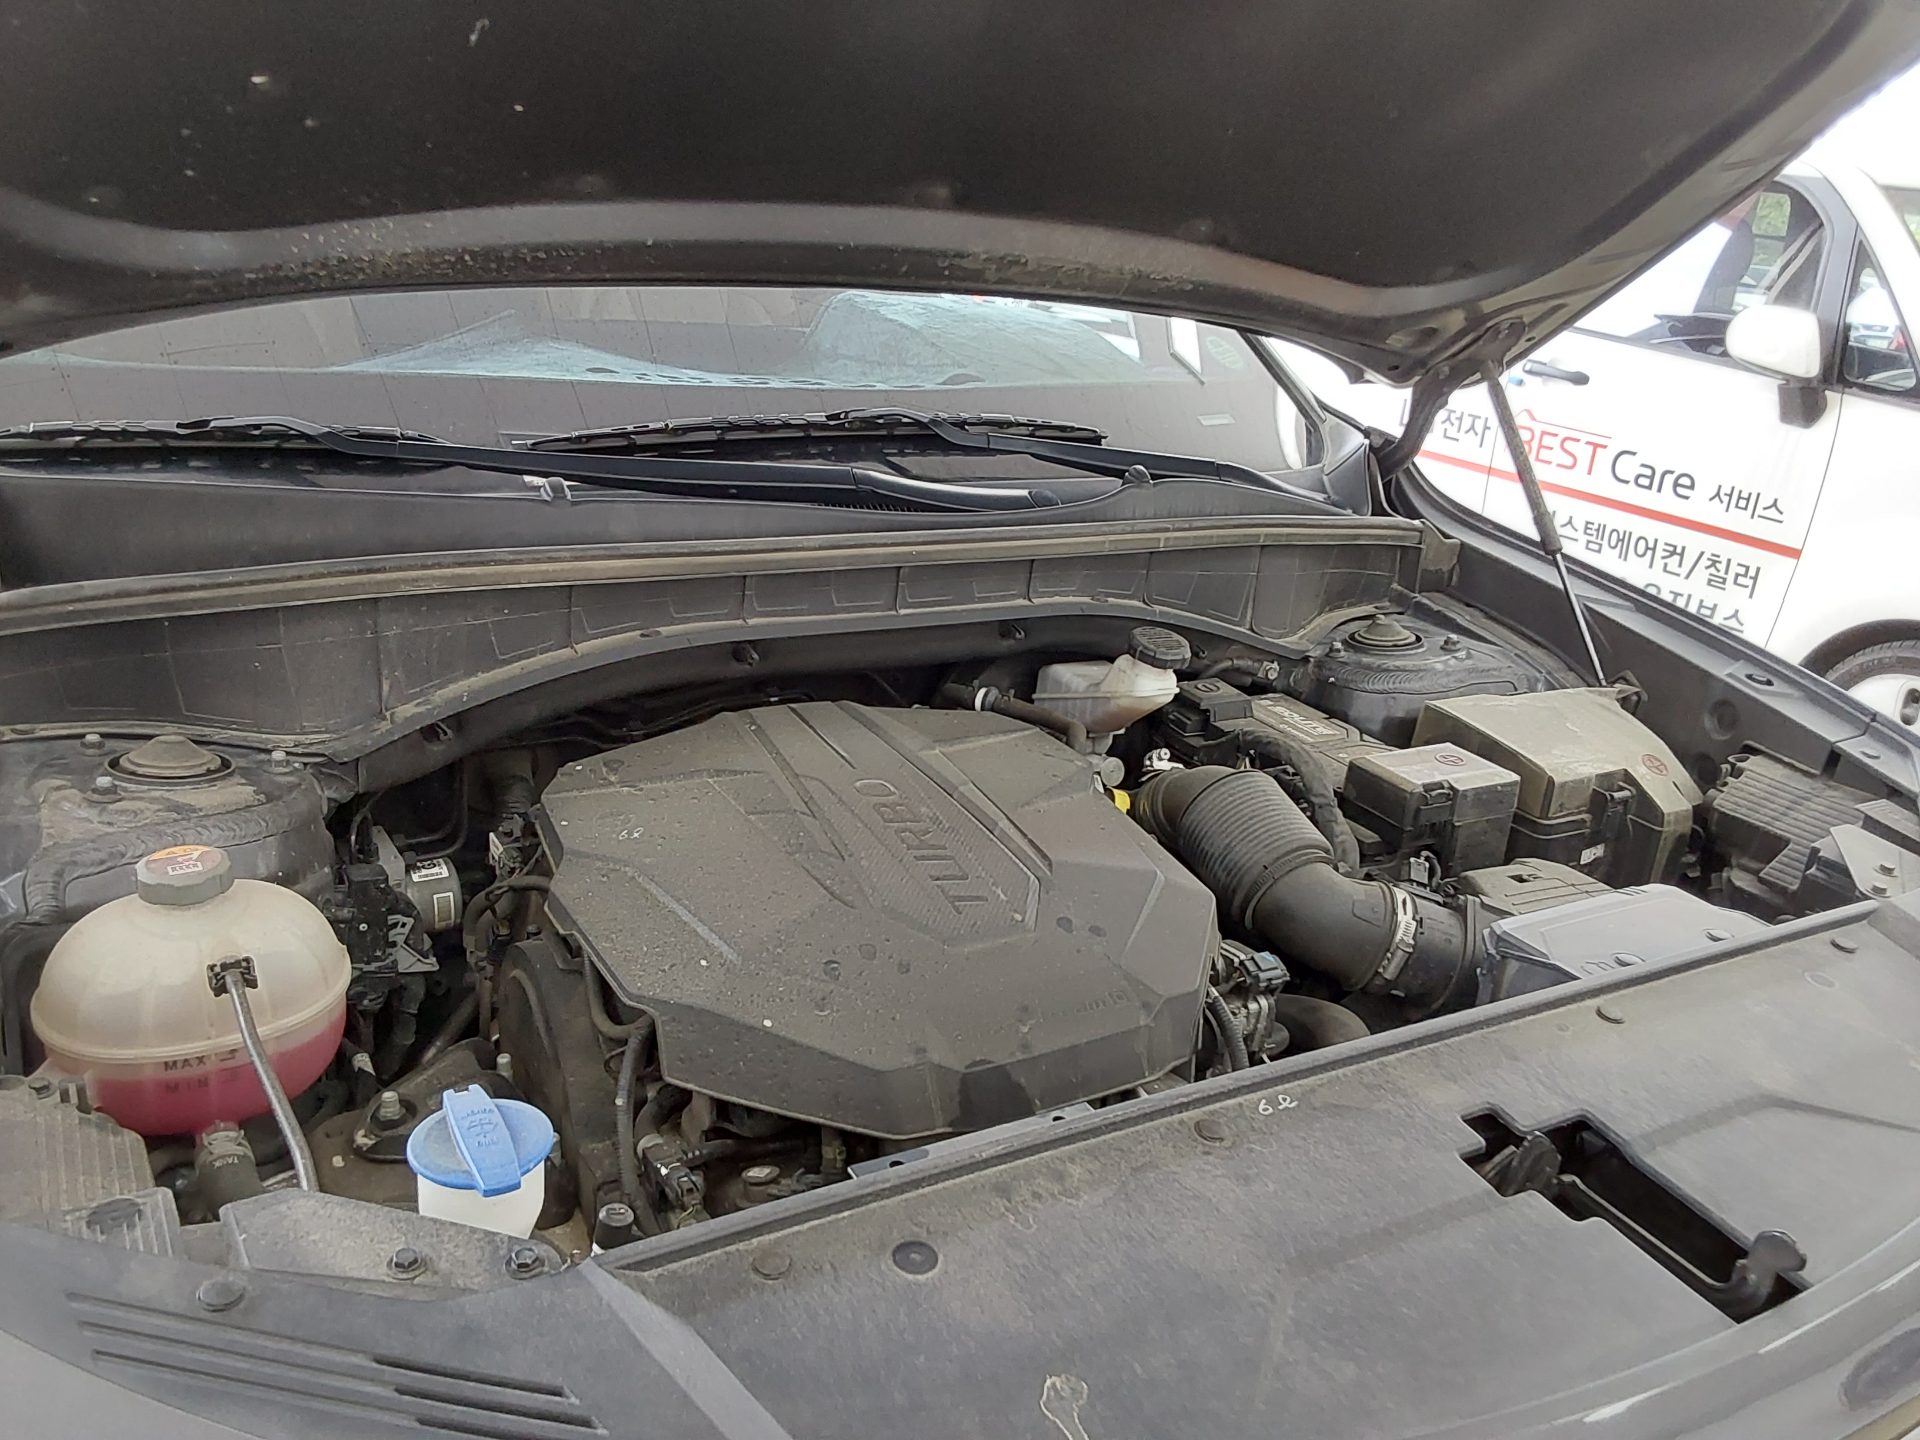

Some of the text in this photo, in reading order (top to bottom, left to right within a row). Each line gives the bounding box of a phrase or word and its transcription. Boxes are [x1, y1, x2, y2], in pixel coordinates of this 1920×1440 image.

[1399, 398, 1491, 449] L전자
[1610, 449, 1696, 500] Care
[1708, 484, 1785, 525] 서비스
[853, 778, 989, 915] TURBO
[163, 1054, 207, 1073] MAX
[164, 1076, 209, 1094] MIN
